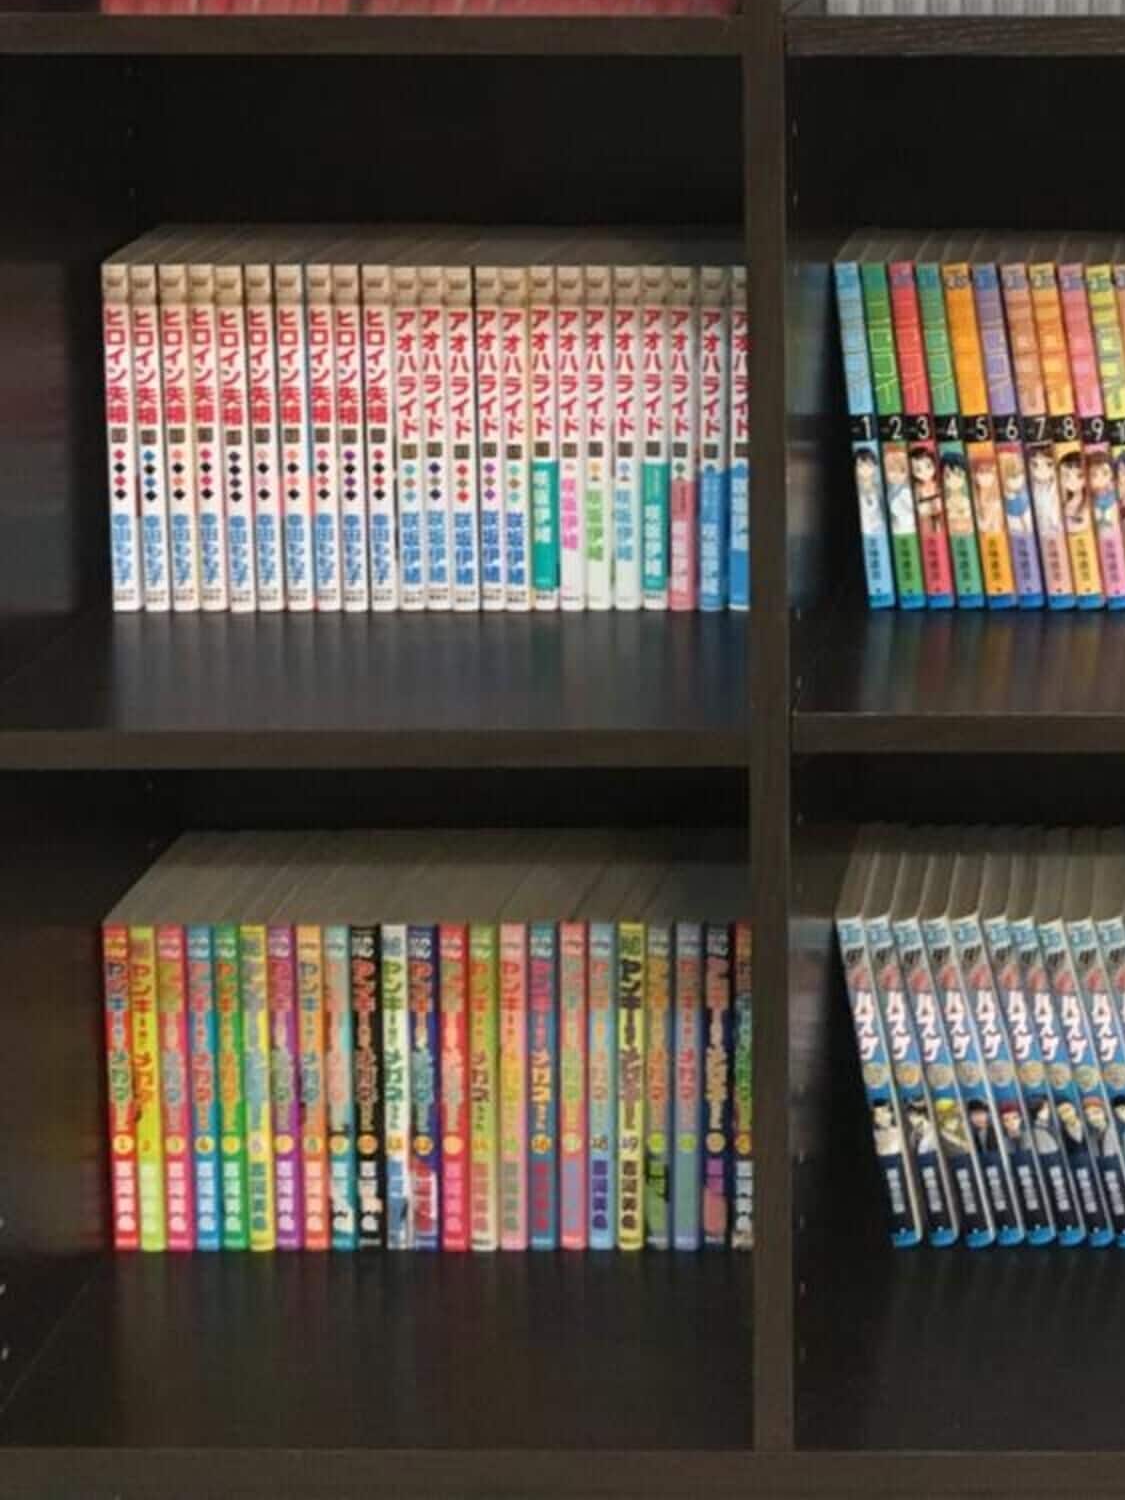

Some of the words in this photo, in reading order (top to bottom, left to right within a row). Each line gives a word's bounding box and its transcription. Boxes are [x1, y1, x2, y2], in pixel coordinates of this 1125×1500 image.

[395, 311, 418, 439] アオハライド
[421, 309, 443, 437] アオハライド
[449, 311, 471, 439] アオハライド
[476, 309, 498, 437] アオハライド
[502, 311, 523, 439] アオハライド
[531, 309, 552, 437] アオハライド
[559, 310, 579, 437] アオハライド
[585, 309, 604, 436] アオハライド
[615, 309, 635, 436] アオハライド
[643, 309, 663, 436] アオハライド
[671, 310, 690, 437] アオハライド
[703, 311, 721, 438] アオハライド
